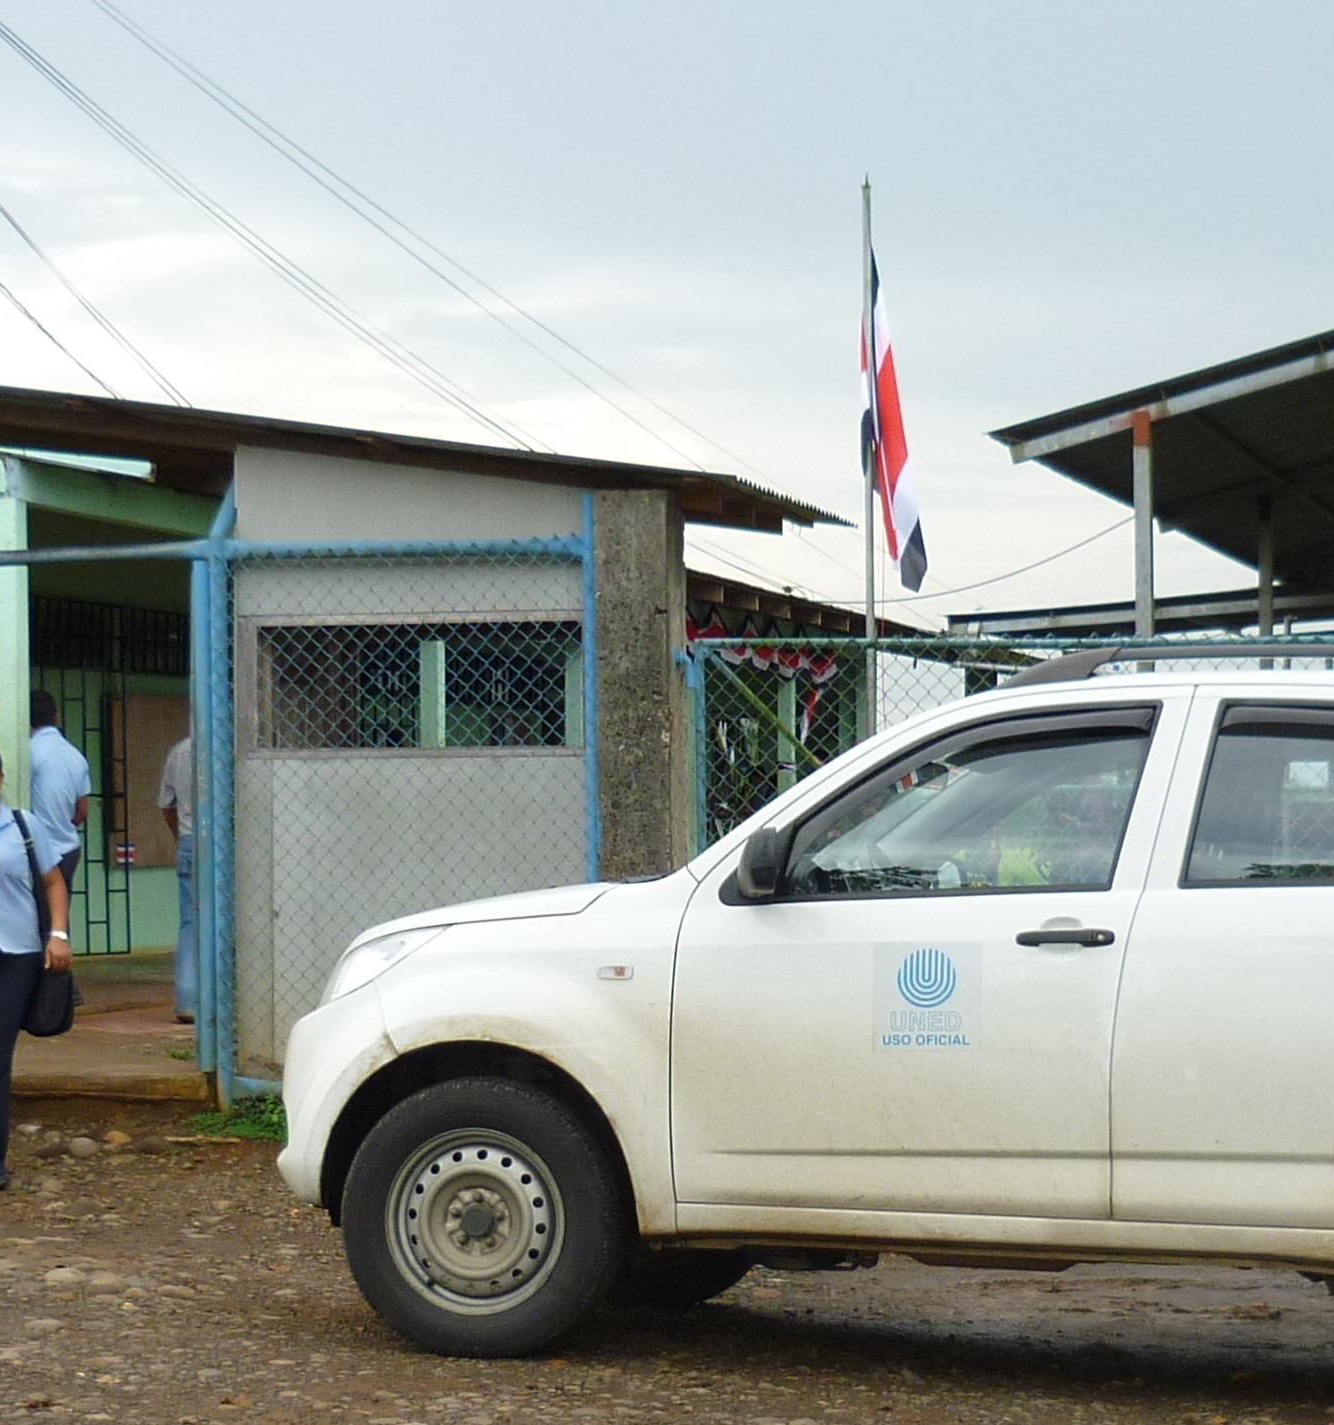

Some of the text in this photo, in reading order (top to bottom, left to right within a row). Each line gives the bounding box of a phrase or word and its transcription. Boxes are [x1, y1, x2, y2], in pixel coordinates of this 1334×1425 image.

[889, 1010, 963, 1032] UNED
[882, 1034, 971, 1046] USO OFICIAL
